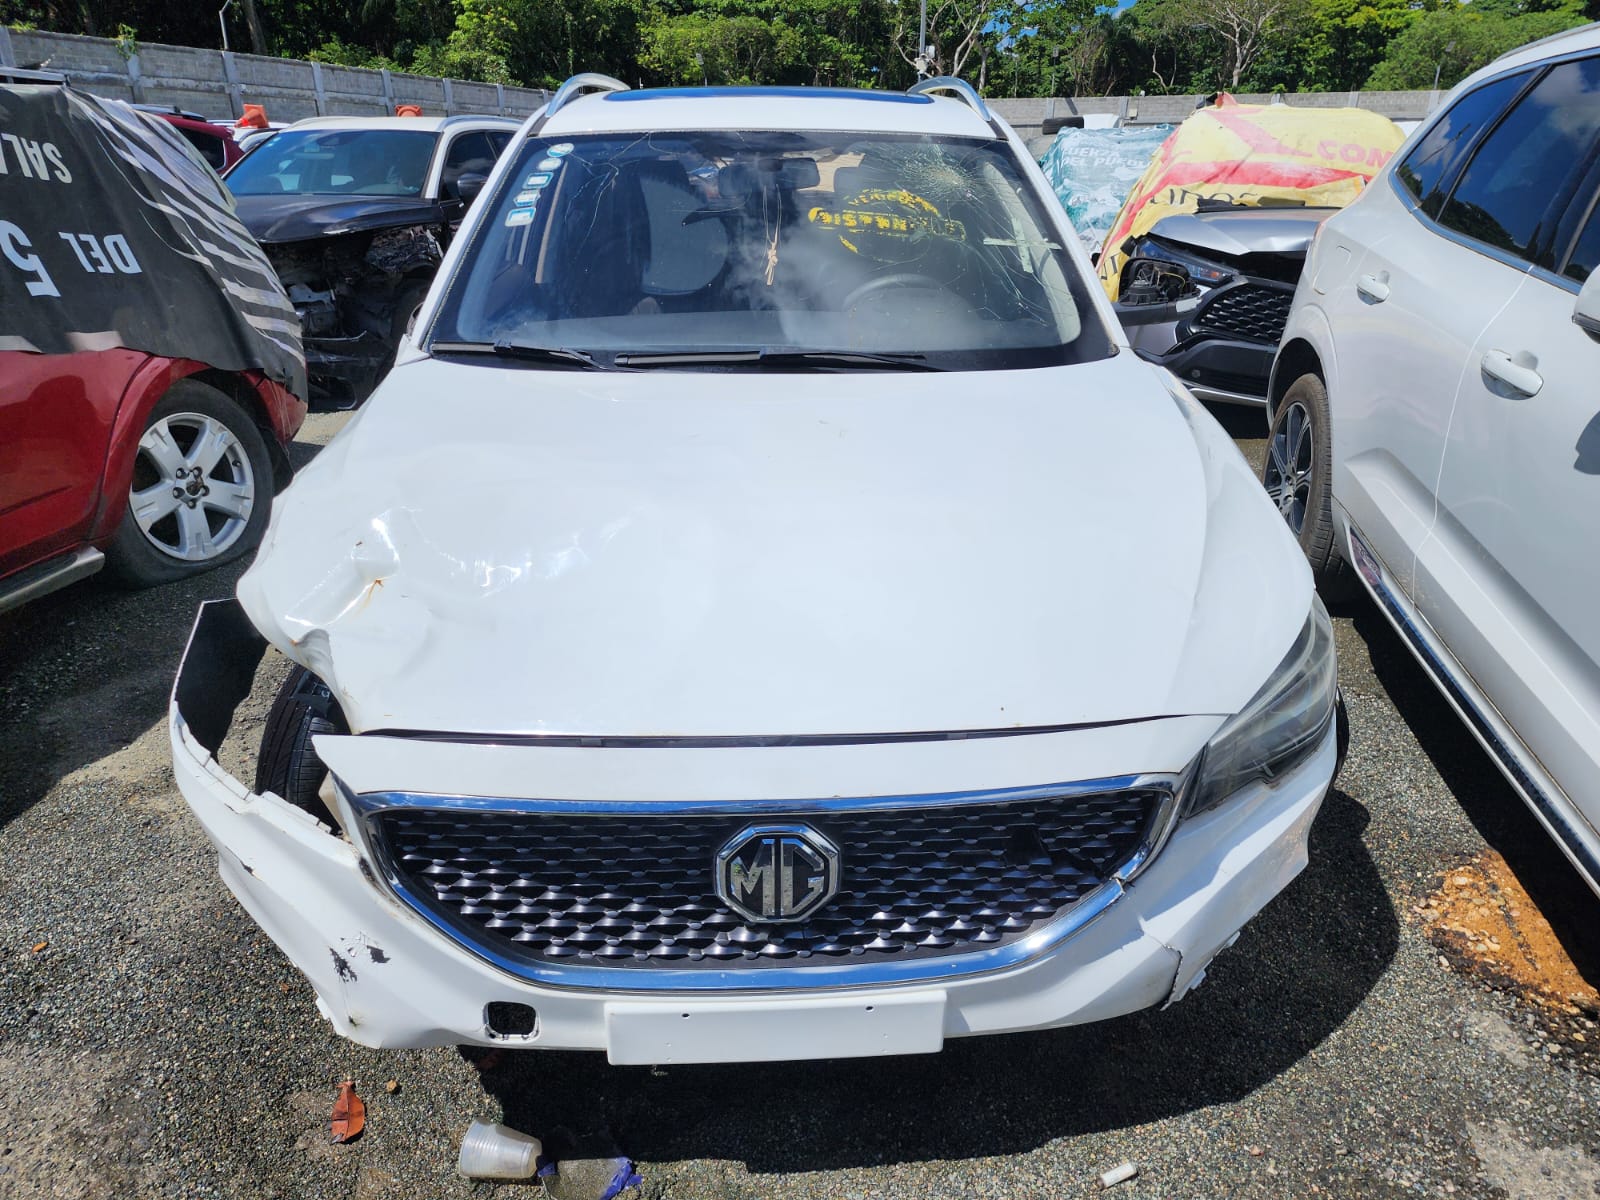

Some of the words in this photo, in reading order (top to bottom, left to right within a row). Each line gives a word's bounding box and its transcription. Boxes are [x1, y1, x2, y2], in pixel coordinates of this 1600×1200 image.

[0, 132, 73, 184] SAL
[58, 231, 143, 274] DEL
[730, 838, 825, 916] MG
